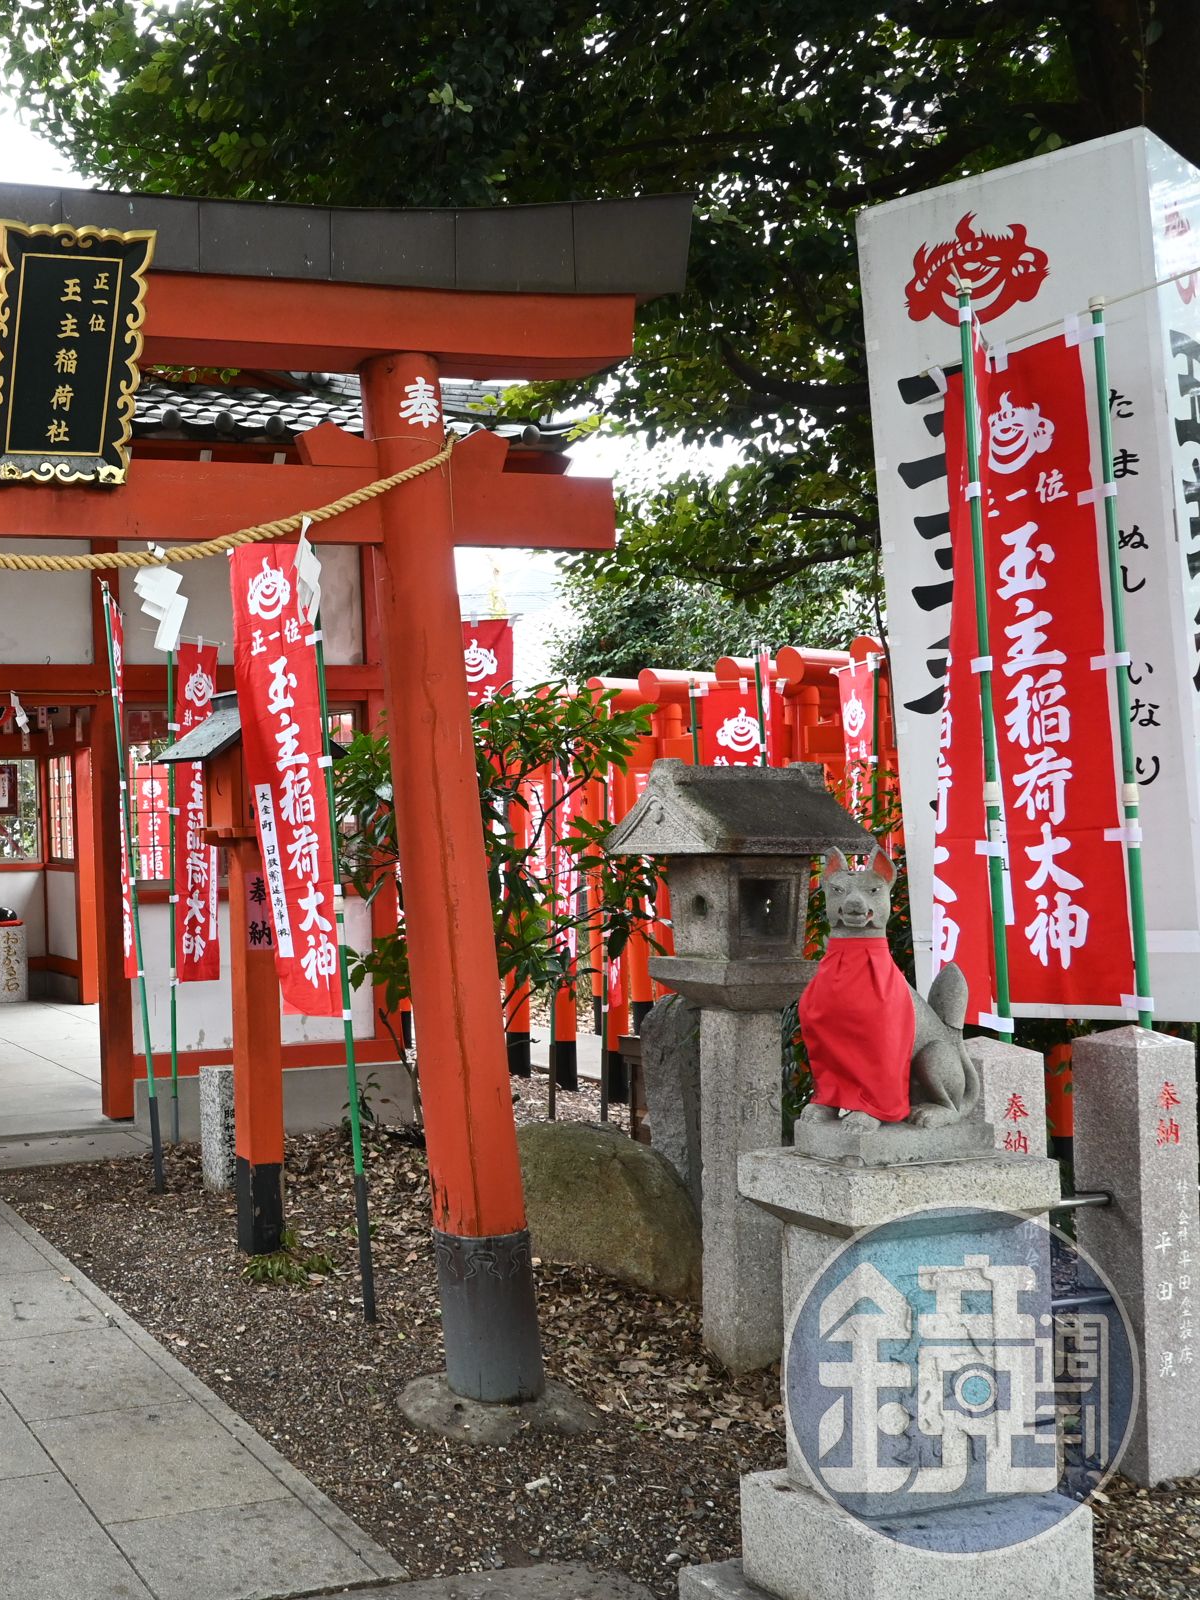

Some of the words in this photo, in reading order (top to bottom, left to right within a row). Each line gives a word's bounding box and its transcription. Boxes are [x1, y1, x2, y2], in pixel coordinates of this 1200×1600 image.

[88, 272, 111, 333] 正一位
[398, 376, 441, 429] 奉
[250, 618, 301, 657] 正一位
[996, 521, 1089, 970] 玉主稲荷大神
[267, 656, 337, 991] 玉主稲荷大神
[249, 877, 273, 946] 奉納
[1003, 1092, 1030, 1154] 奉納
[1156, 1081, 1181, 1146] 奉納
